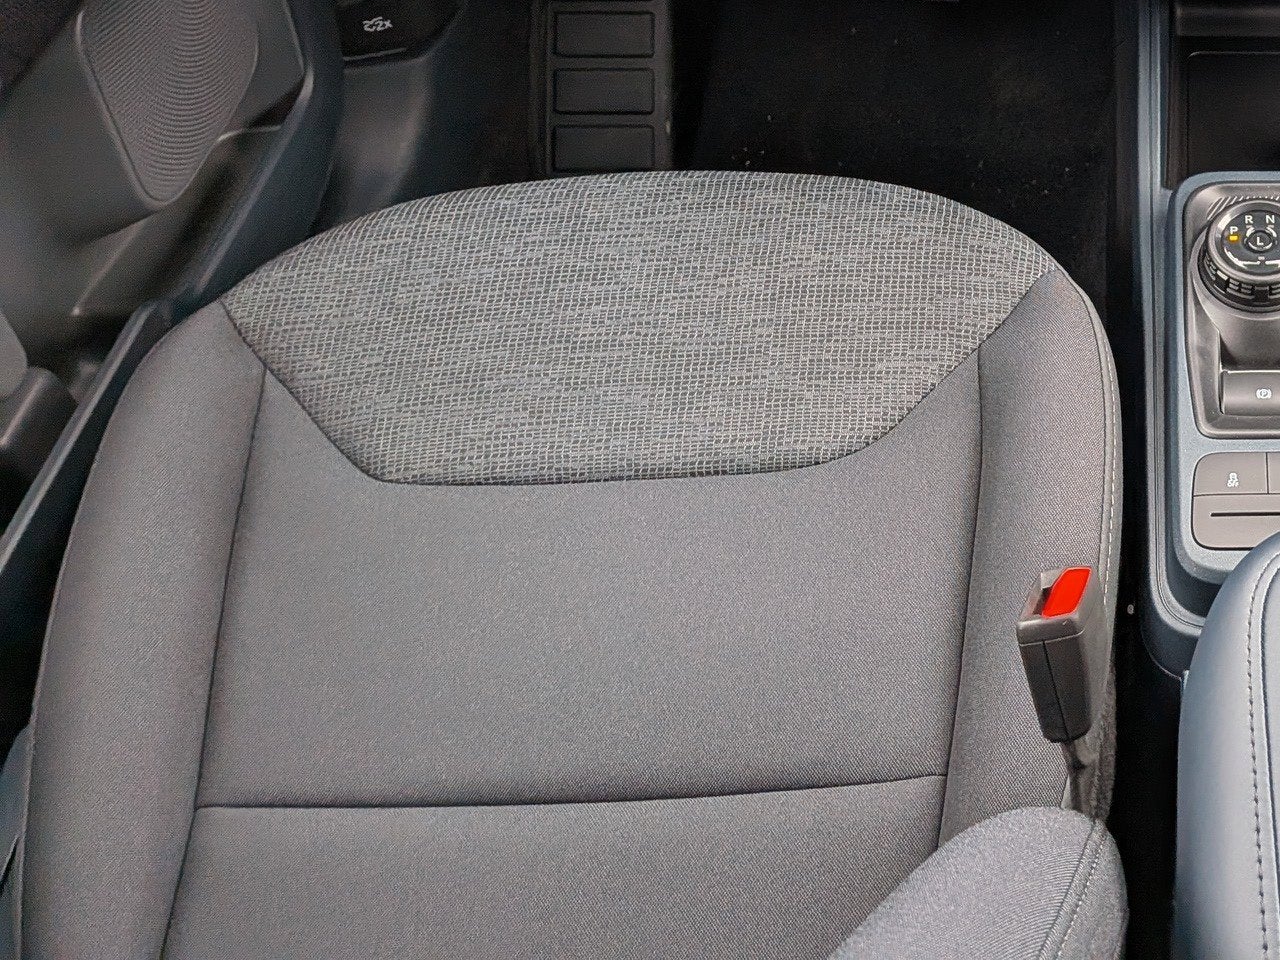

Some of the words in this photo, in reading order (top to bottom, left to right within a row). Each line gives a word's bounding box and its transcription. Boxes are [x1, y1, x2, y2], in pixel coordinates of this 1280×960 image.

[1245, 215, 1253, 224] R
[1266, 215, 1275, 224] N
[1230, 226, 1239, 234] P
[1256, 236, 1264, 246] L
